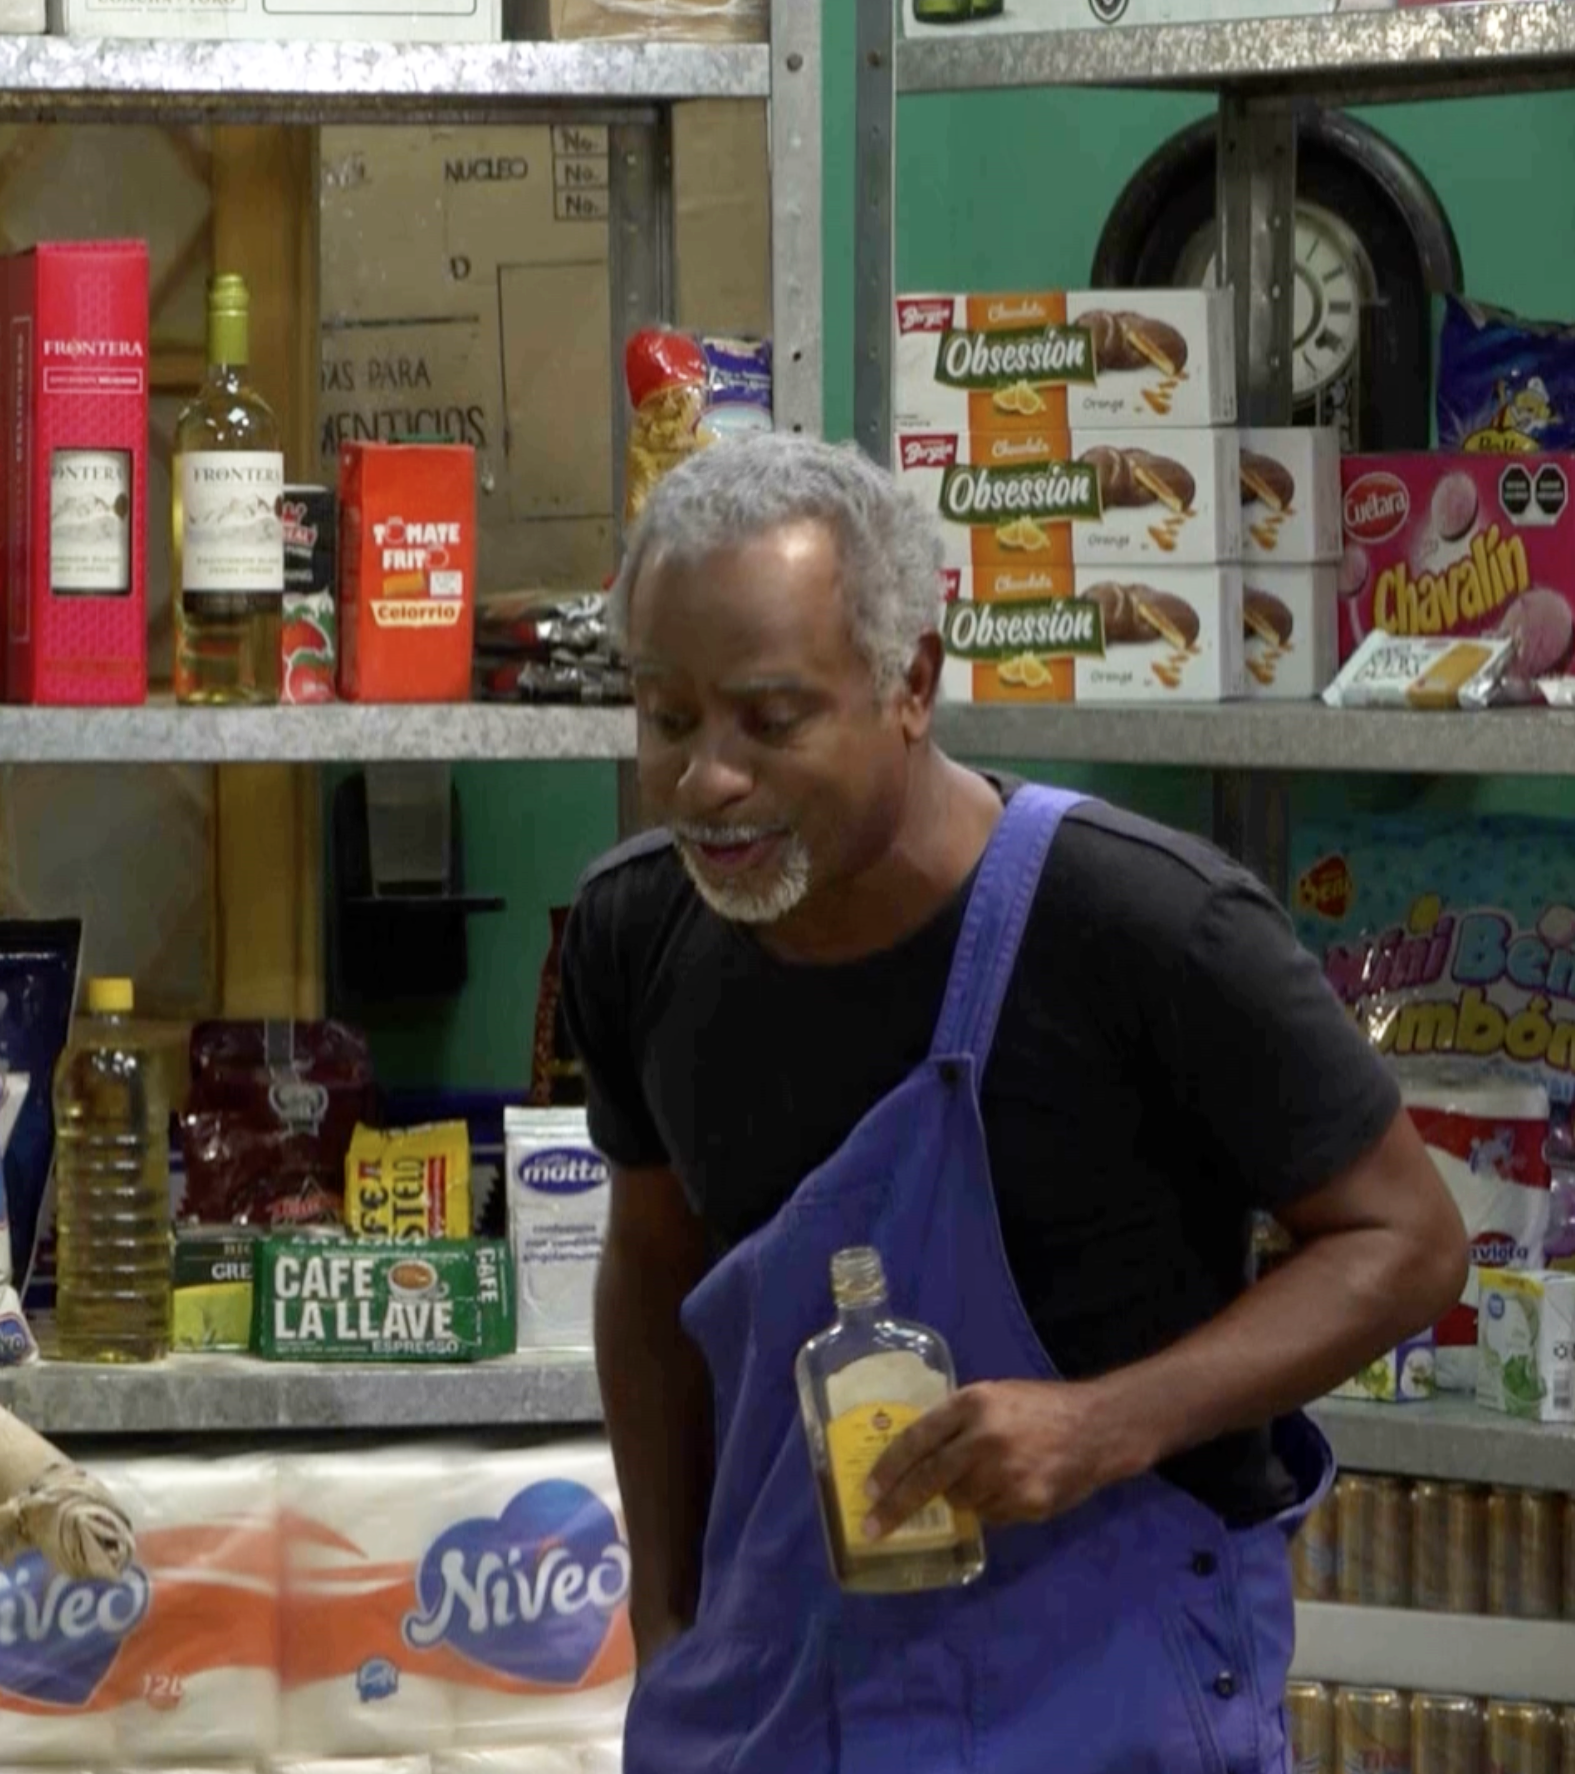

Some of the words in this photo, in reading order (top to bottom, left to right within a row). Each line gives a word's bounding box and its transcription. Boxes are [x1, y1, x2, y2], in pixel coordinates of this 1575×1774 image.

[444, 156, 528, 182] NUCLEO
[43, 339, 144, 359] FRONTERA
[946, 328, 1085, 377] Obsession
[368, 356, 433, 390] PARA
[948, 465, 1091, 514] Obsession
[372, 516, 461, 546] TOMATE
[382, 545, 450, 570] FRITO
[377, 603, 456, 621] Celorrio
[951, 601, 1093, 649] Obsession
[1347, 988, 1575, 1072] mbón
[523, 1158, 609, 1182] motta
[1467, 1242, 1530, 1260] aviota
[211, 1261, 252, 1281] GRE
[274, 1256, 375, 1299] CAFE
[475, 1247, 499, 1304] CAFE
[274, 1299, 326, 1339] LA
[335, 1299, 454, 1340] LLAVE
[371, 1340, 459, 1355] ESPRESSO
[409, 1543, 631, 1644] Niveo
